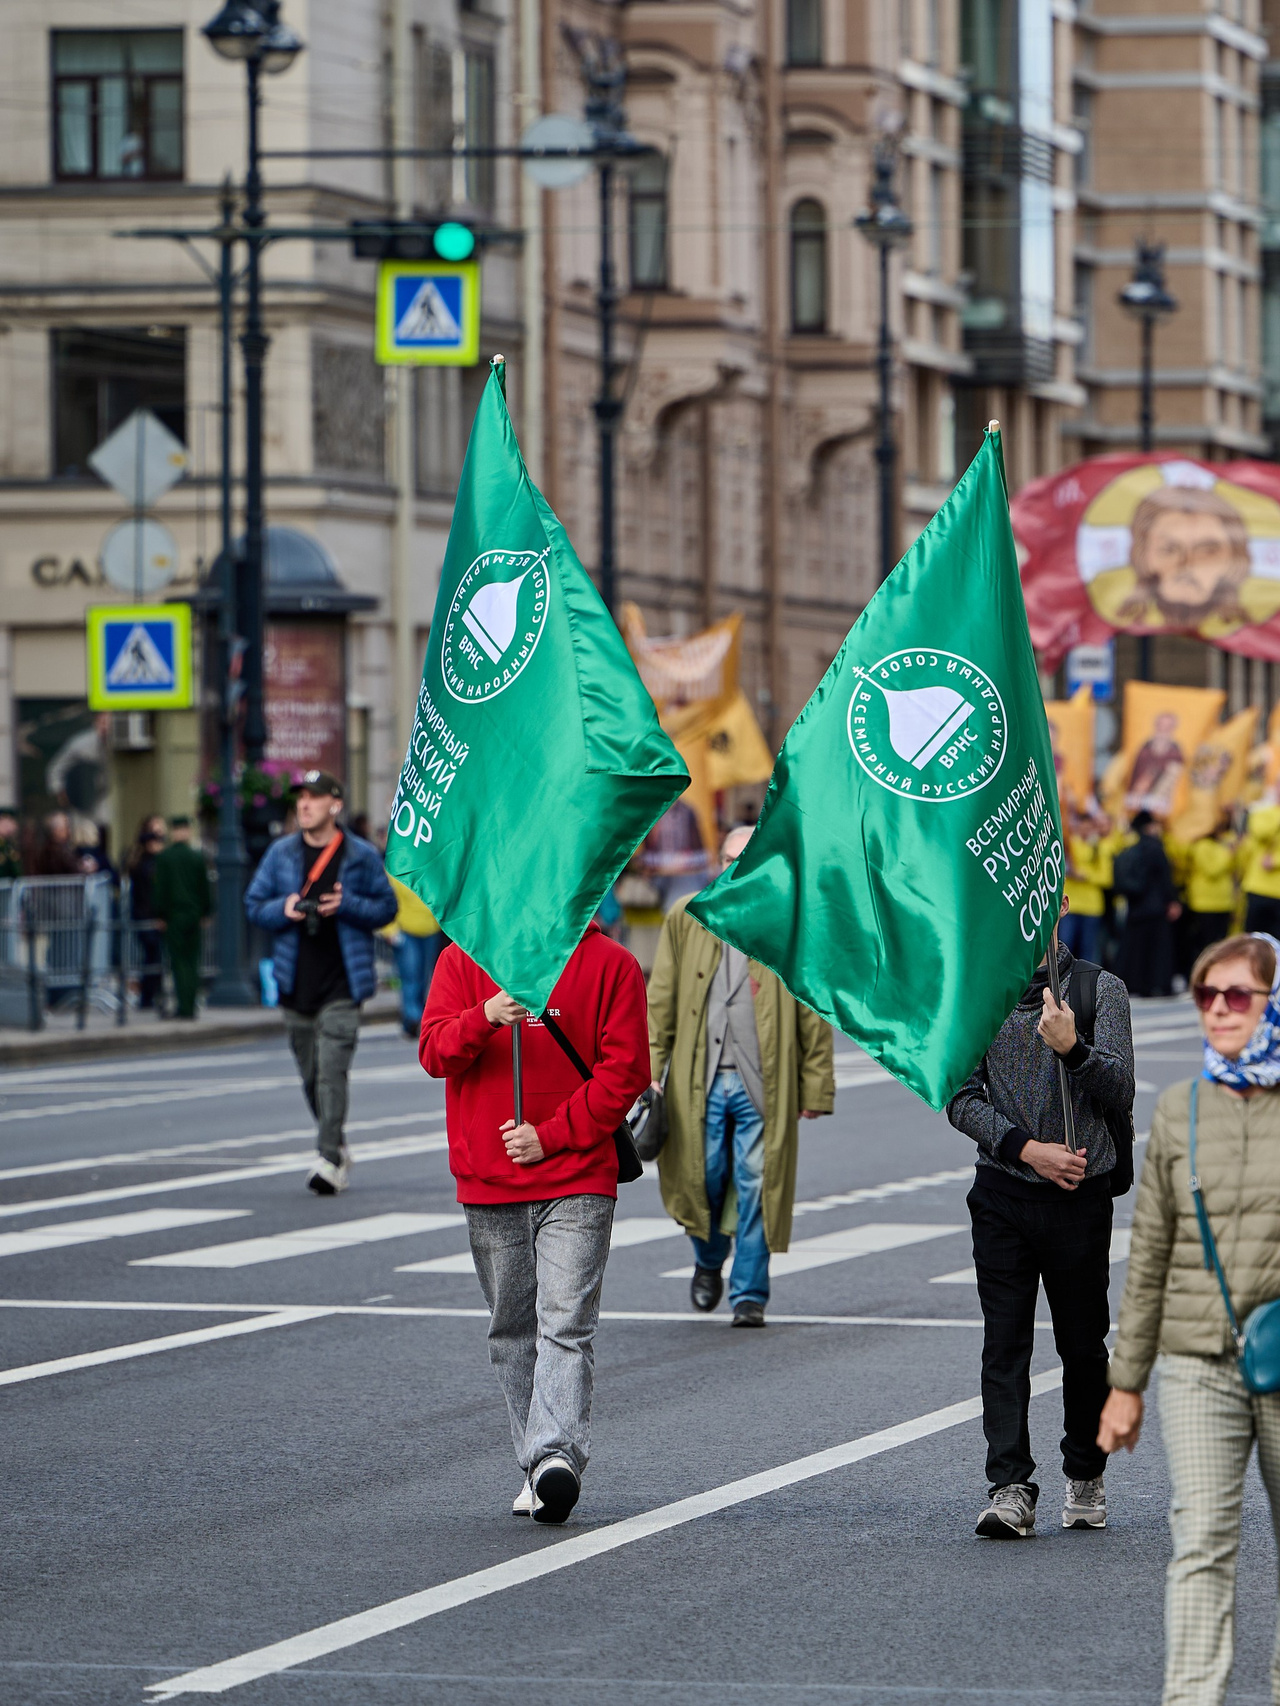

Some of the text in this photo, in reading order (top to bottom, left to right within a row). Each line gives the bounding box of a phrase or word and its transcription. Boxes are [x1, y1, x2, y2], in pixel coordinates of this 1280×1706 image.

[444, 554, 545, 697] ВСЕМИРНЫЙ РУССКИЙ НАРОДНЫЙ СОБОР
[458, 634, 484, 671] ВРНС
[411, 701, 457, 794] ССКИЙ
[854, 654, 1003, 796] ВСЕМИРНЫЙ РУССКИЙ НАРОДНЫЙ СОБОР
[938, 727, 978, 769] ВРНС
[390, 772, 433, 848] БОР
[965, 756, 1038, 857] ВСЕМИРНЫЙ
[982, 779, 1046, 884] РУССКИЙ
[1001, 809, 1055, 908] НАРОДНЫЙ
[1019, 839, 1062, 942] СОБОР
